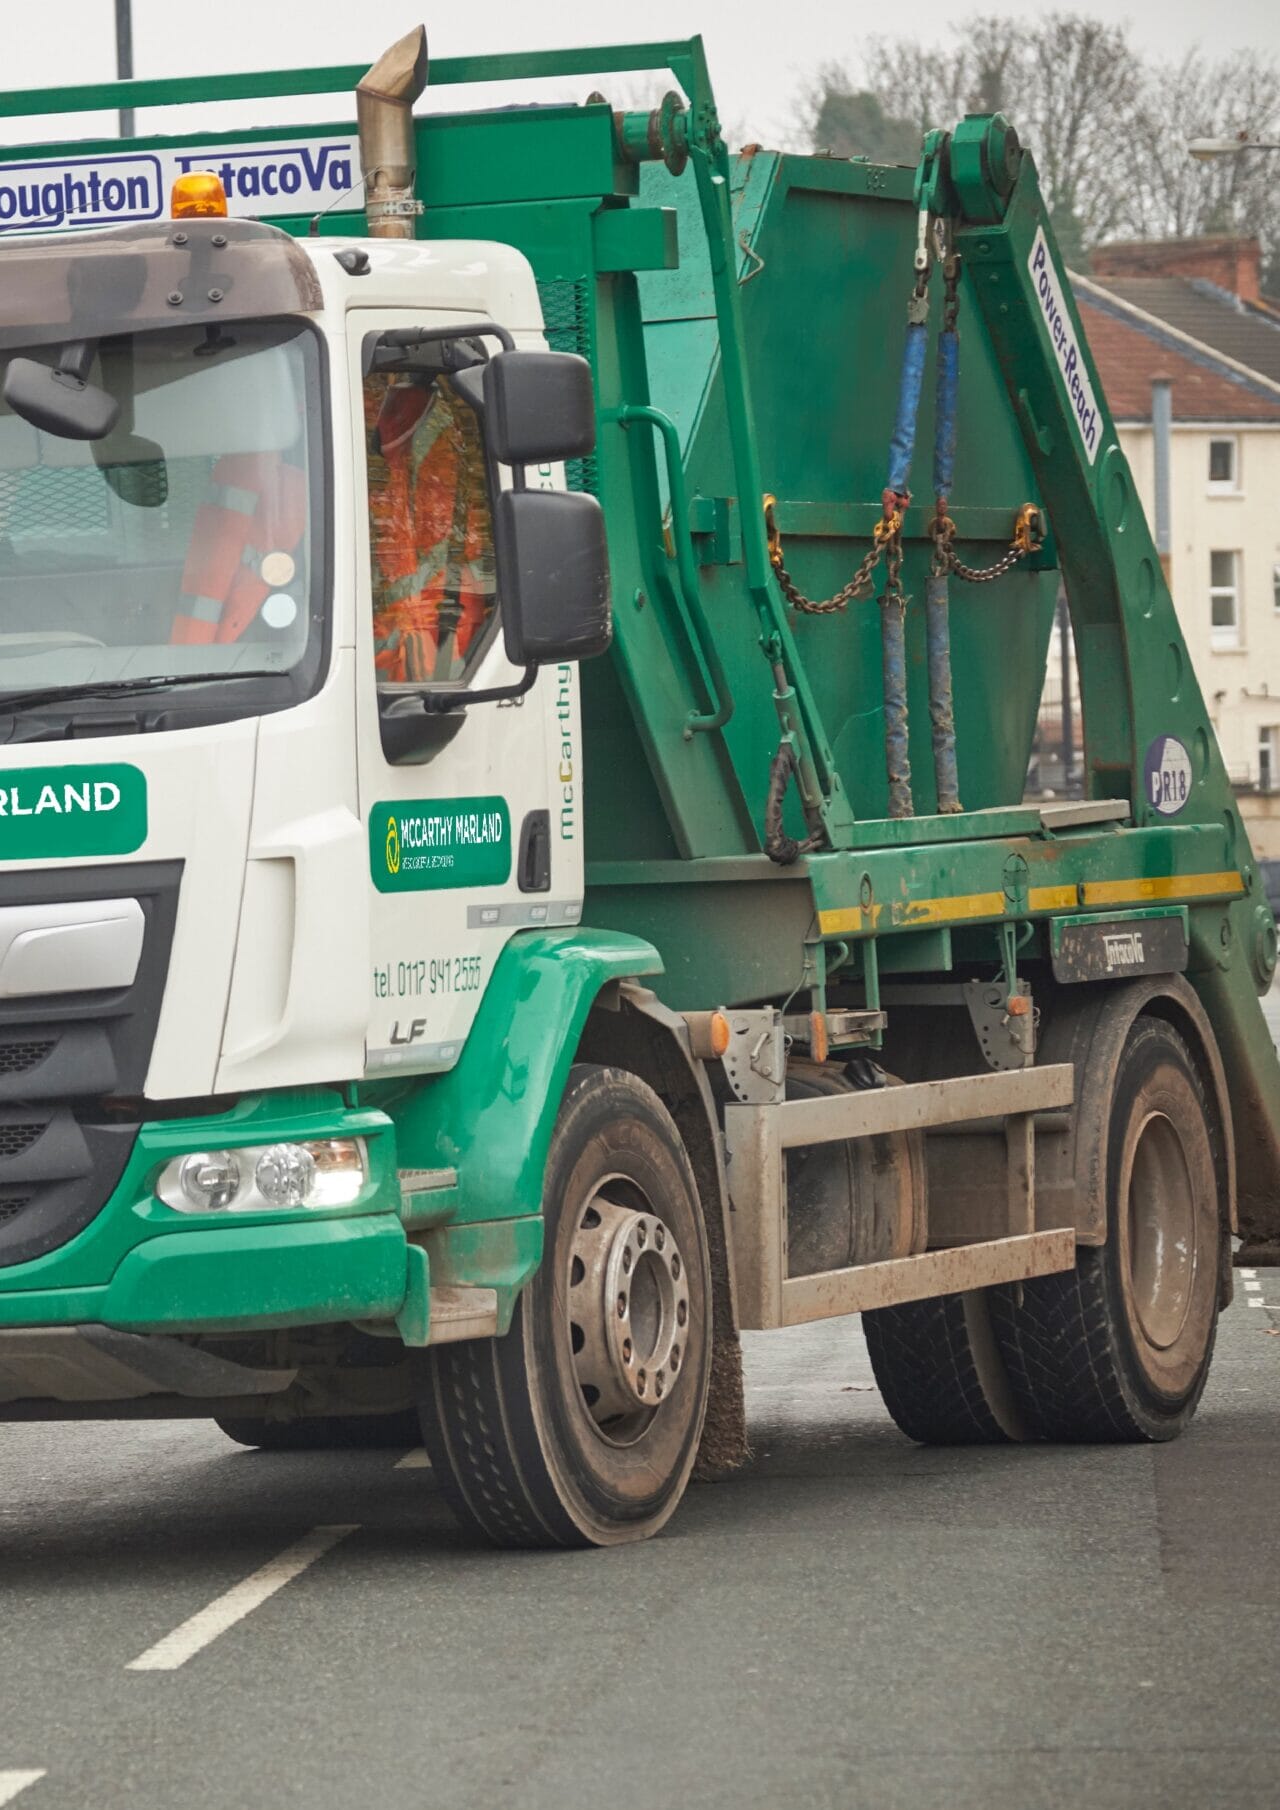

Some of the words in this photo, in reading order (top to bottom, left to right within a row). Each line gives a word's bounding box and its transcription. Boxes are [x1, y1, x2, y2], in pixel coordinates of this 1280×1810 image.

[174, 144, 352, 197] tacoVa
[1033, 241, 1097, 451] Power-Reach
[1151, 769, 1186, 803] PR18
[400, 816, 454, 848] MCCARTHY
[455, 812, 502, 844] MARLAND
[374, 965, 395, 998] tel.
[398, 960, 426, 996] 0117
[429, 959, 452, 994] 941
[454, 956, 482, 992] 2555
[389, 1018, 428, 1045] LF
